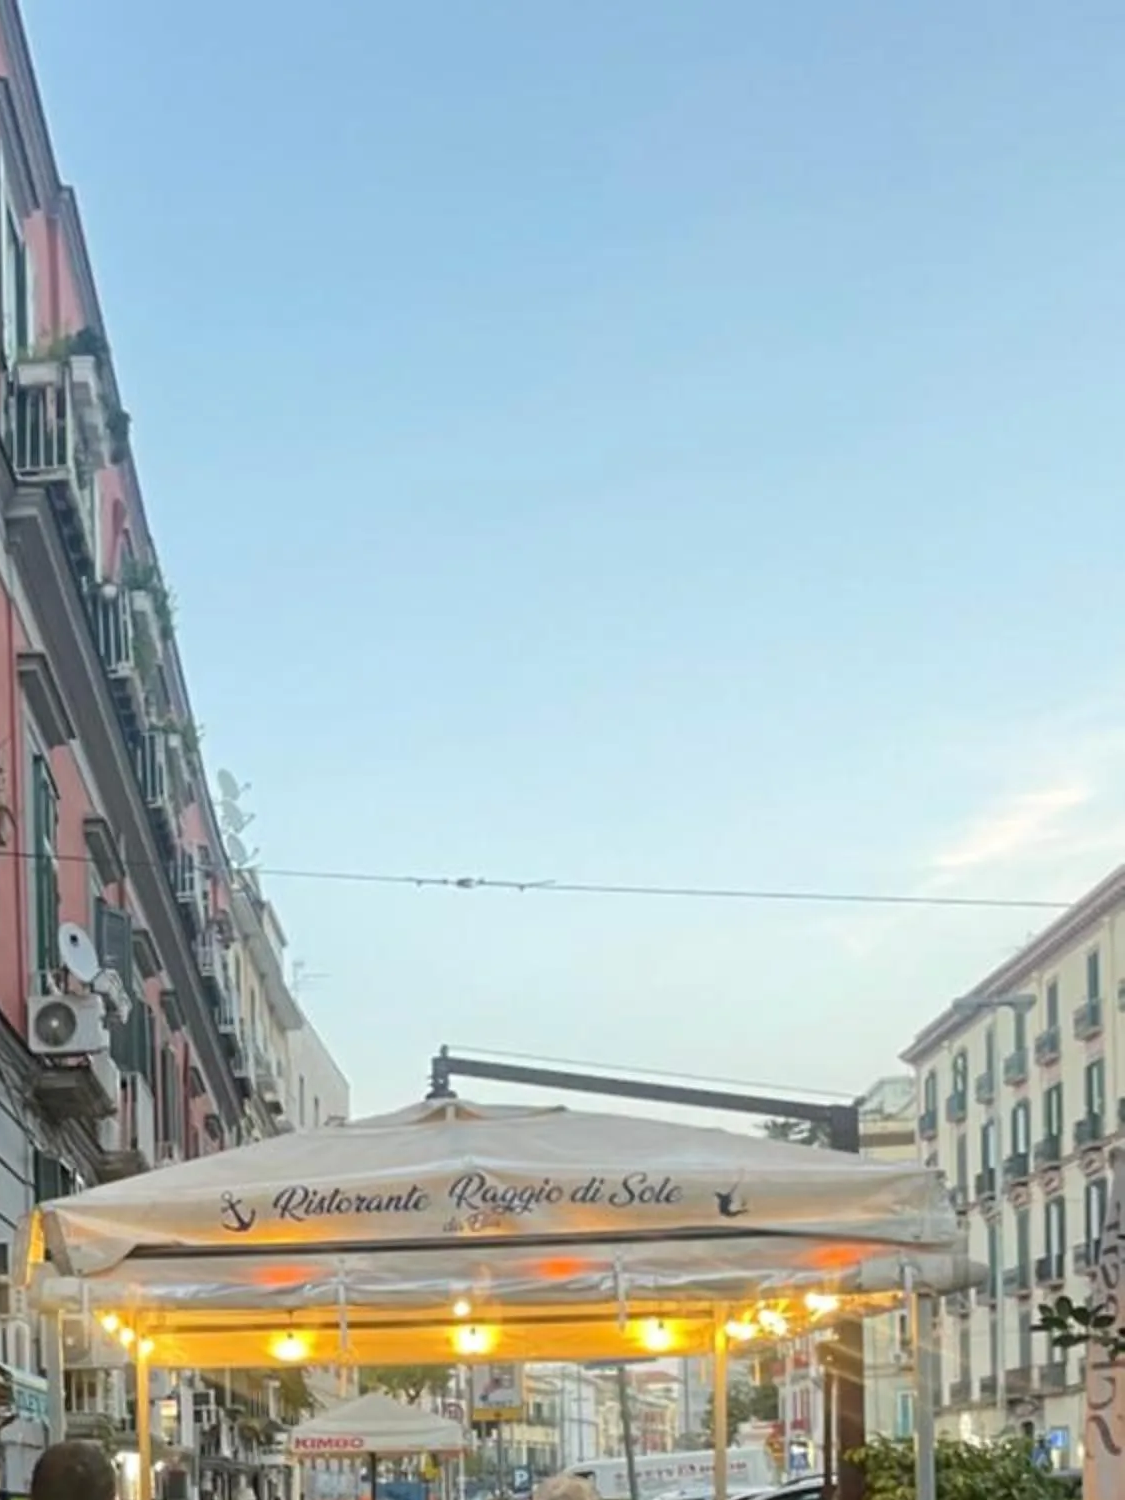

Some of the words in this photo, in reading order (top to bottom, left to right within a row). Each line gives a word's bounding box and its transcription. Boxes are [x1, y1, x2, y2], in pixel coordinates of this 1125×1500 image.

[273, 1184, 431, 1222] Ristorante
[448, 1172, 564, 1215] Raggio
[571, 1176, 603, 1204] di
[609, 1172, 683, 1208] Sole
[295, 1436, 364, 1450] KIMBO
[515, 1469, 528, 1487] P
